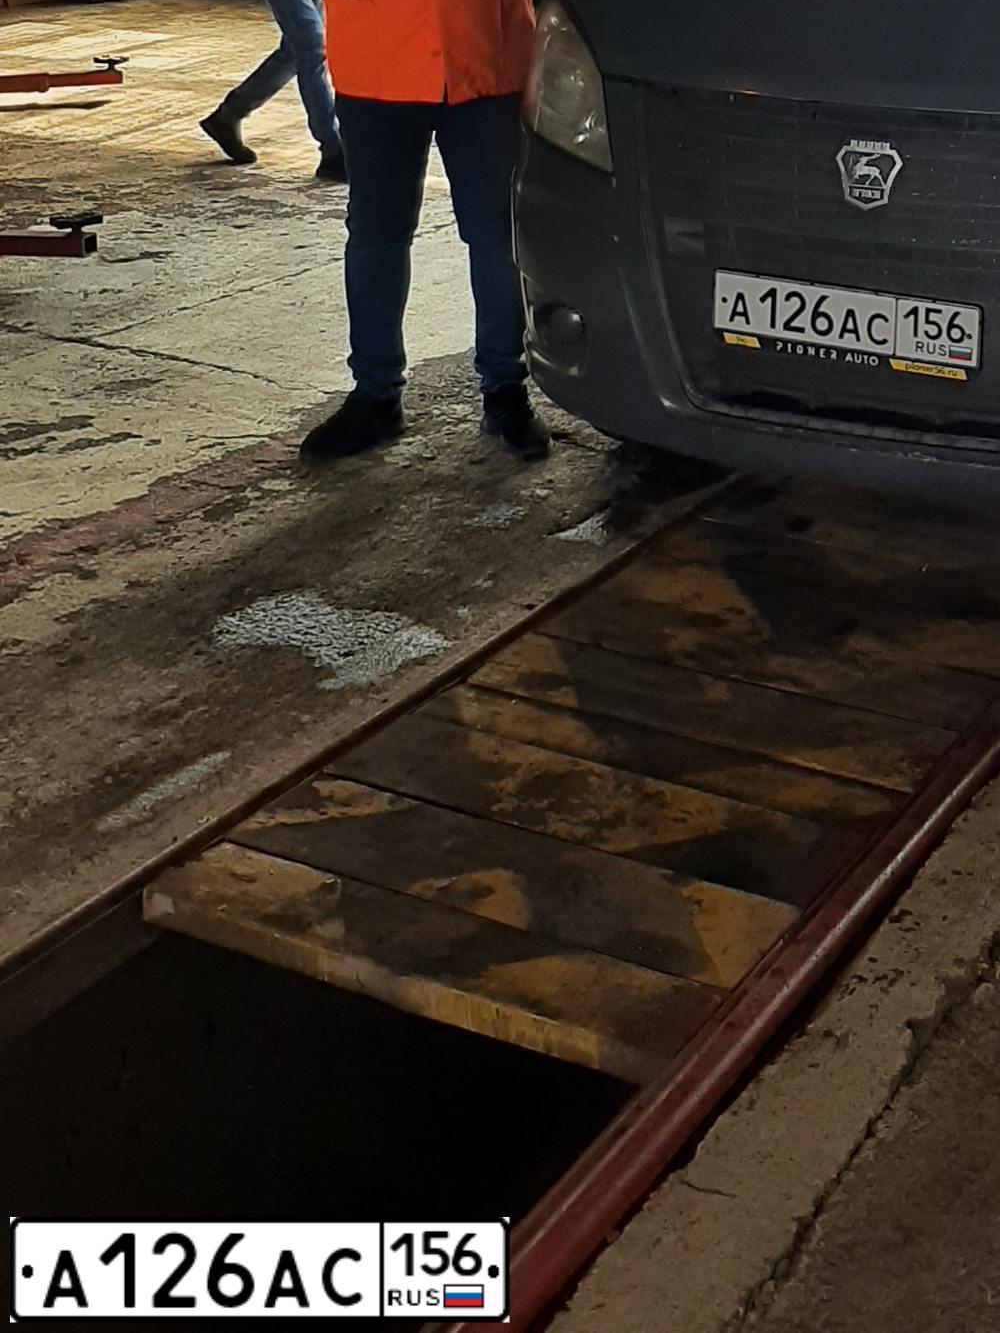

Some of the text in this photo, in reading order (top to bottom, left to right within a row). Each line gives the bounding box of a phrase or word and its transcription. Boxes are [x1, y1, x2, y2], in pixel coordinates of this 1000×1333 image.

[903, 305, 967, 344] 156
[915, 340, 948, 357] RUS
[844, 352, 879, 366] AUTO
